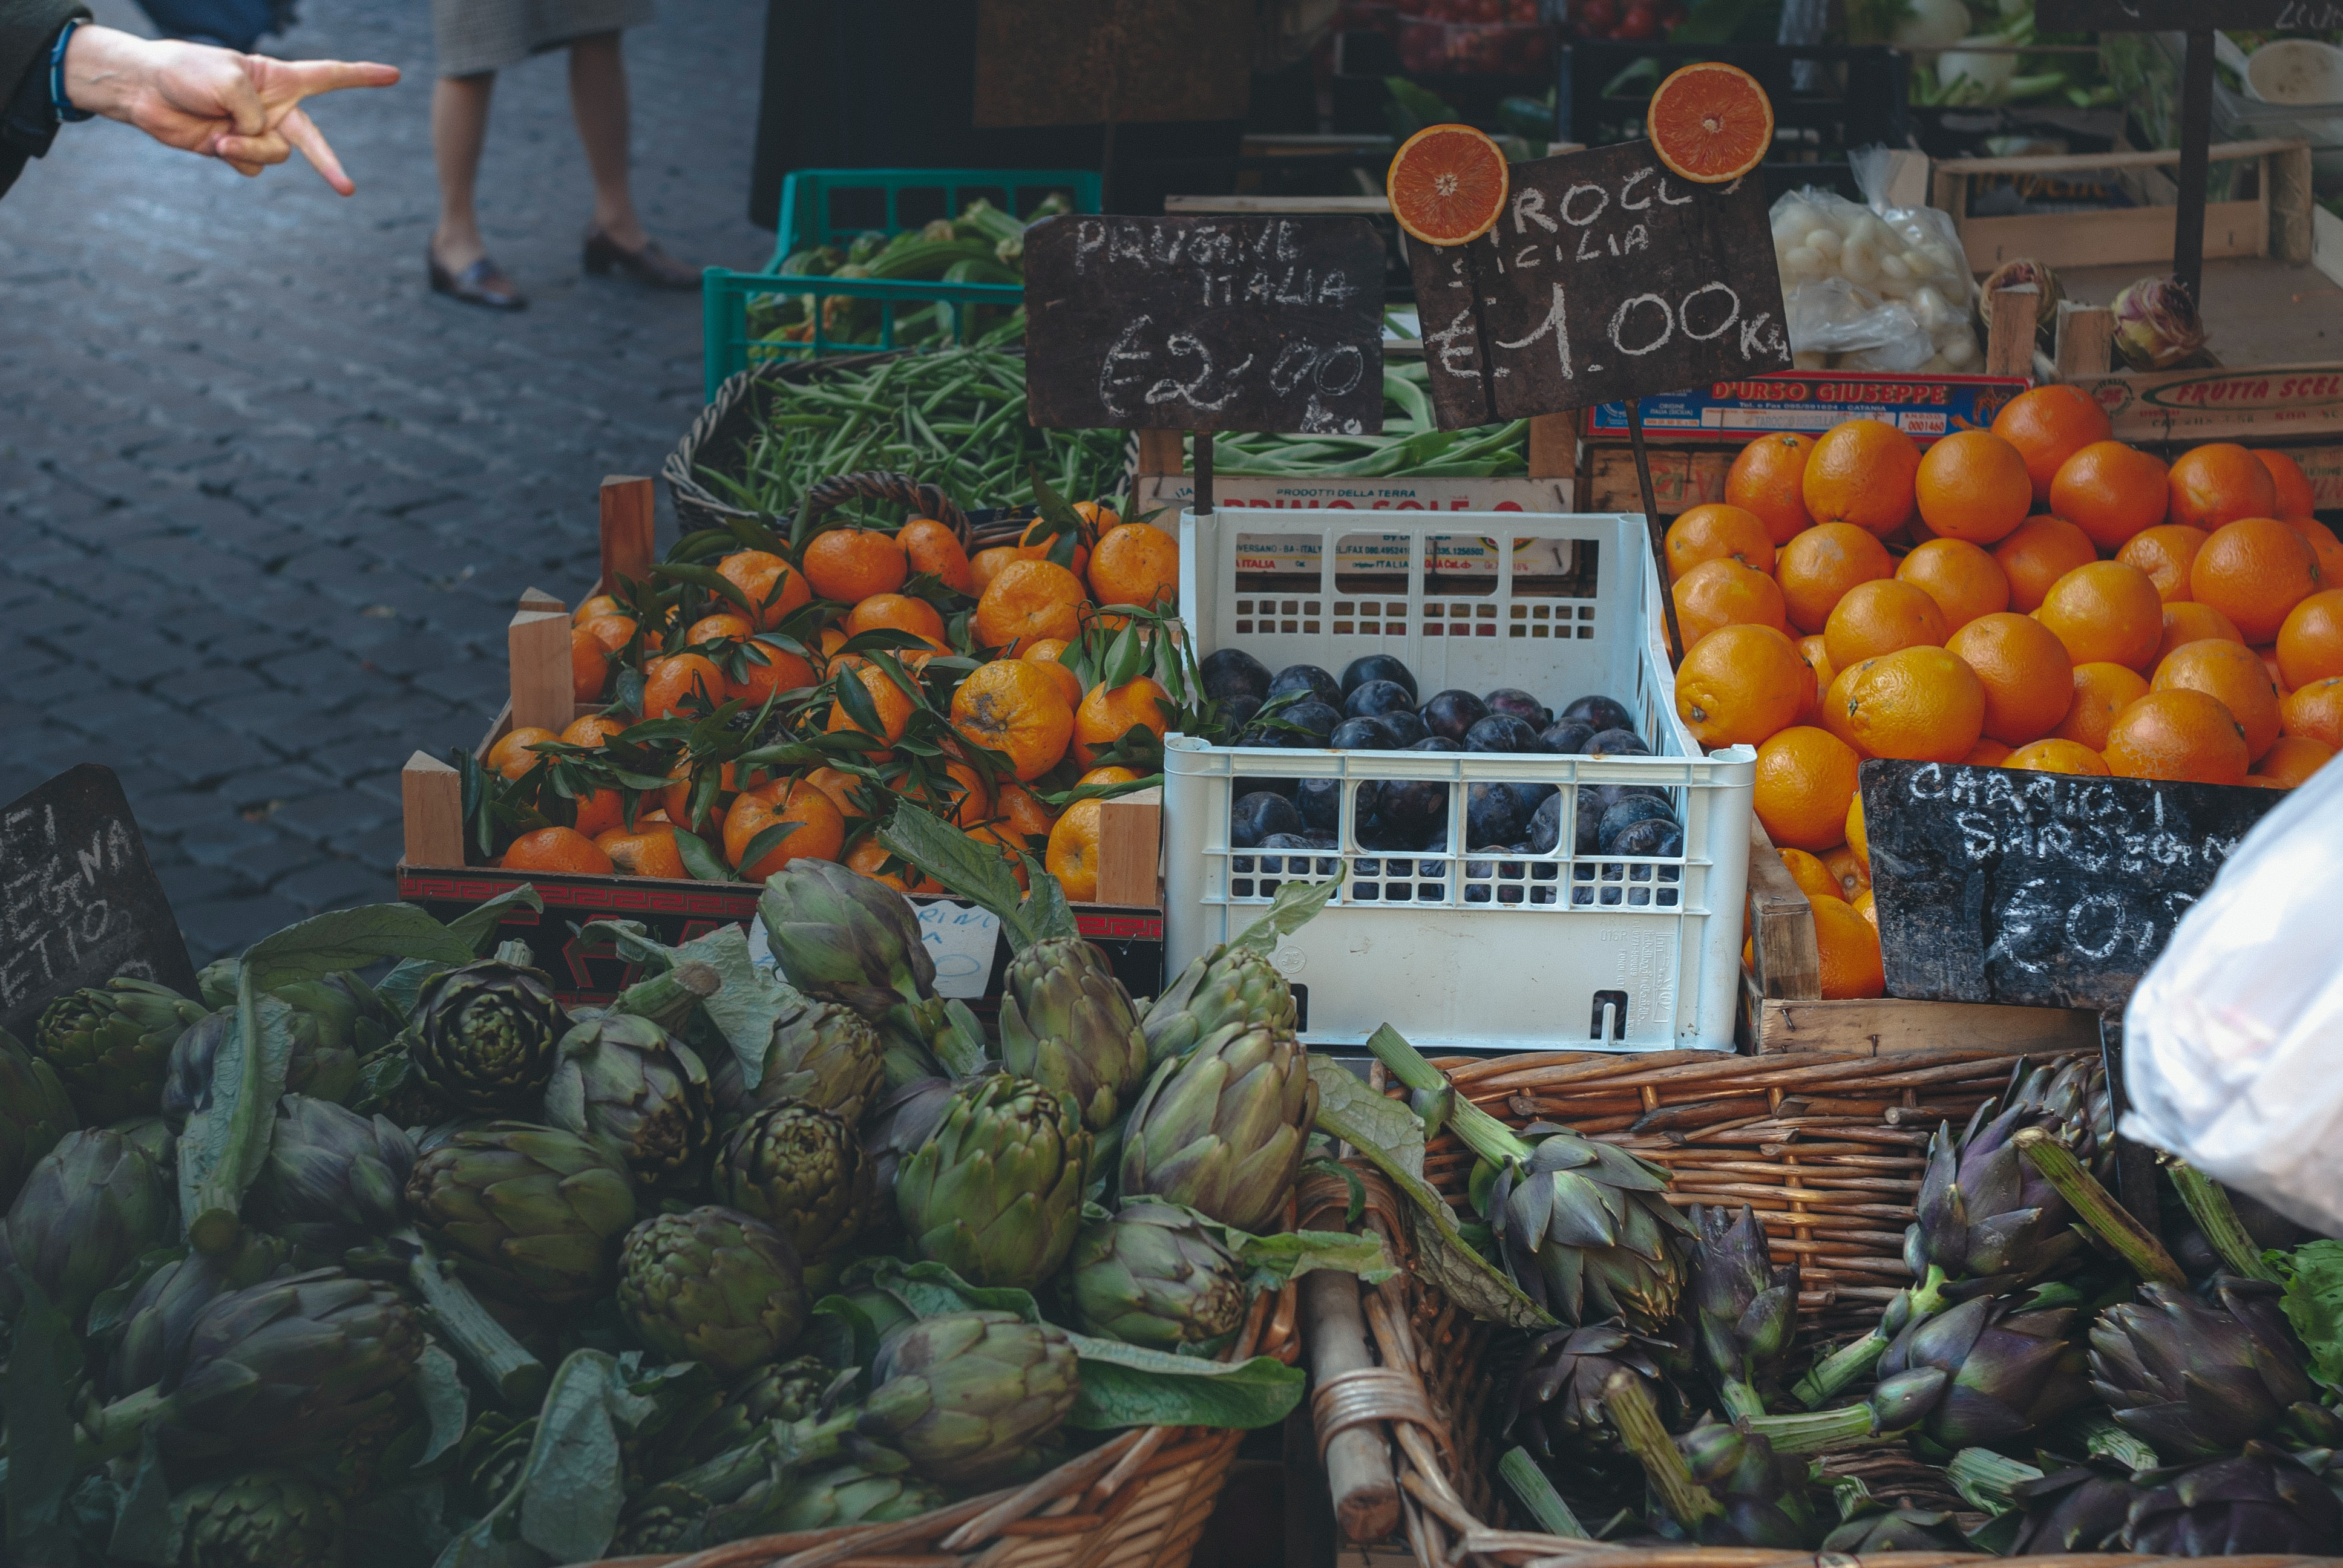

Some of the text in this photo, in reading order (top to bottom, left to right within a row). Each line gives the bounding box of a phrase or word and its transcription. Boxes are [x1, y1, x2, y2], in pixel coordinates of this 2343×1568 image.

[1712, 381, 1806, 402] D'URSO
[1816, 382, 1947, 405] GIUSEPPE
[2177, 379, 2269, 402] FRUTTA
[1277, 489, 1335, 497] PRODOTTI
[1378, 489, 1416, 498] TERRA
